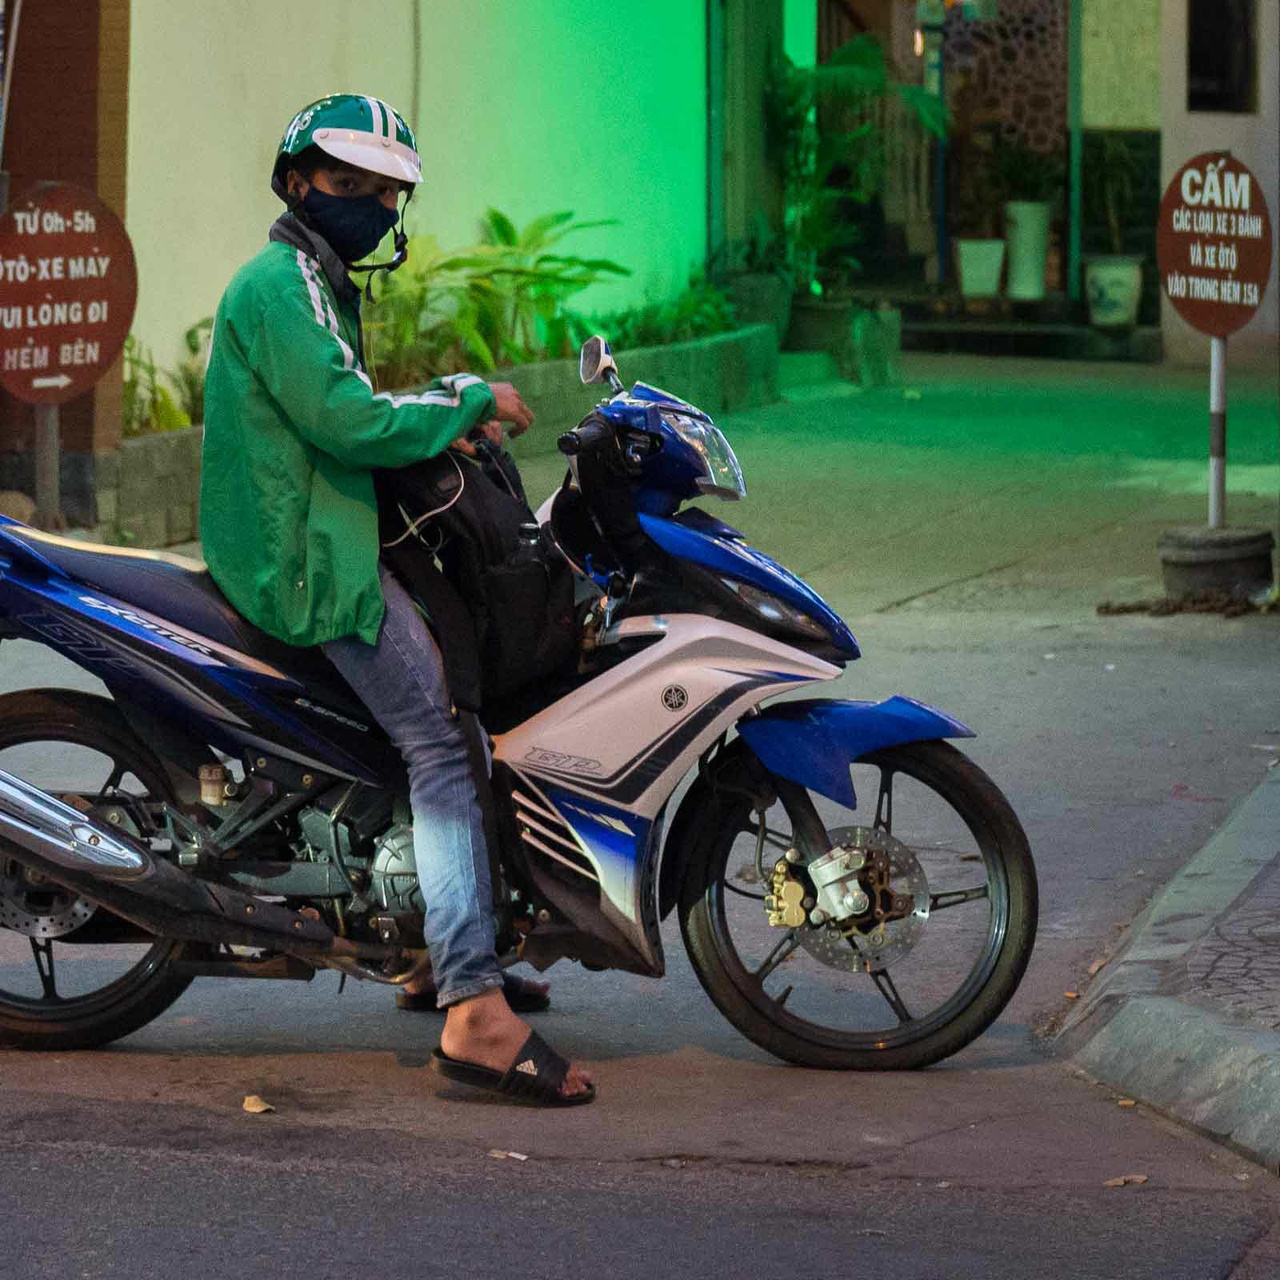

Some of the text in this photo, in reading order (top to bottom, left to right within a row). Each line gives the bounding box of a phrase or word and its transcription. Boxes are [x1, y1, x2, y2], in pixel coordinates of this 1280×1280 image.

[1181, 158, 1250, 210] CẤM
[1173, 205, 1191, 232] CÁC
[1216, 212, 1228, 236] XE
[1230, 214, 1236, 236] 3
[1204, 244, 1216, 269] XE
[1188, 276, 1219, 302] TRONG
